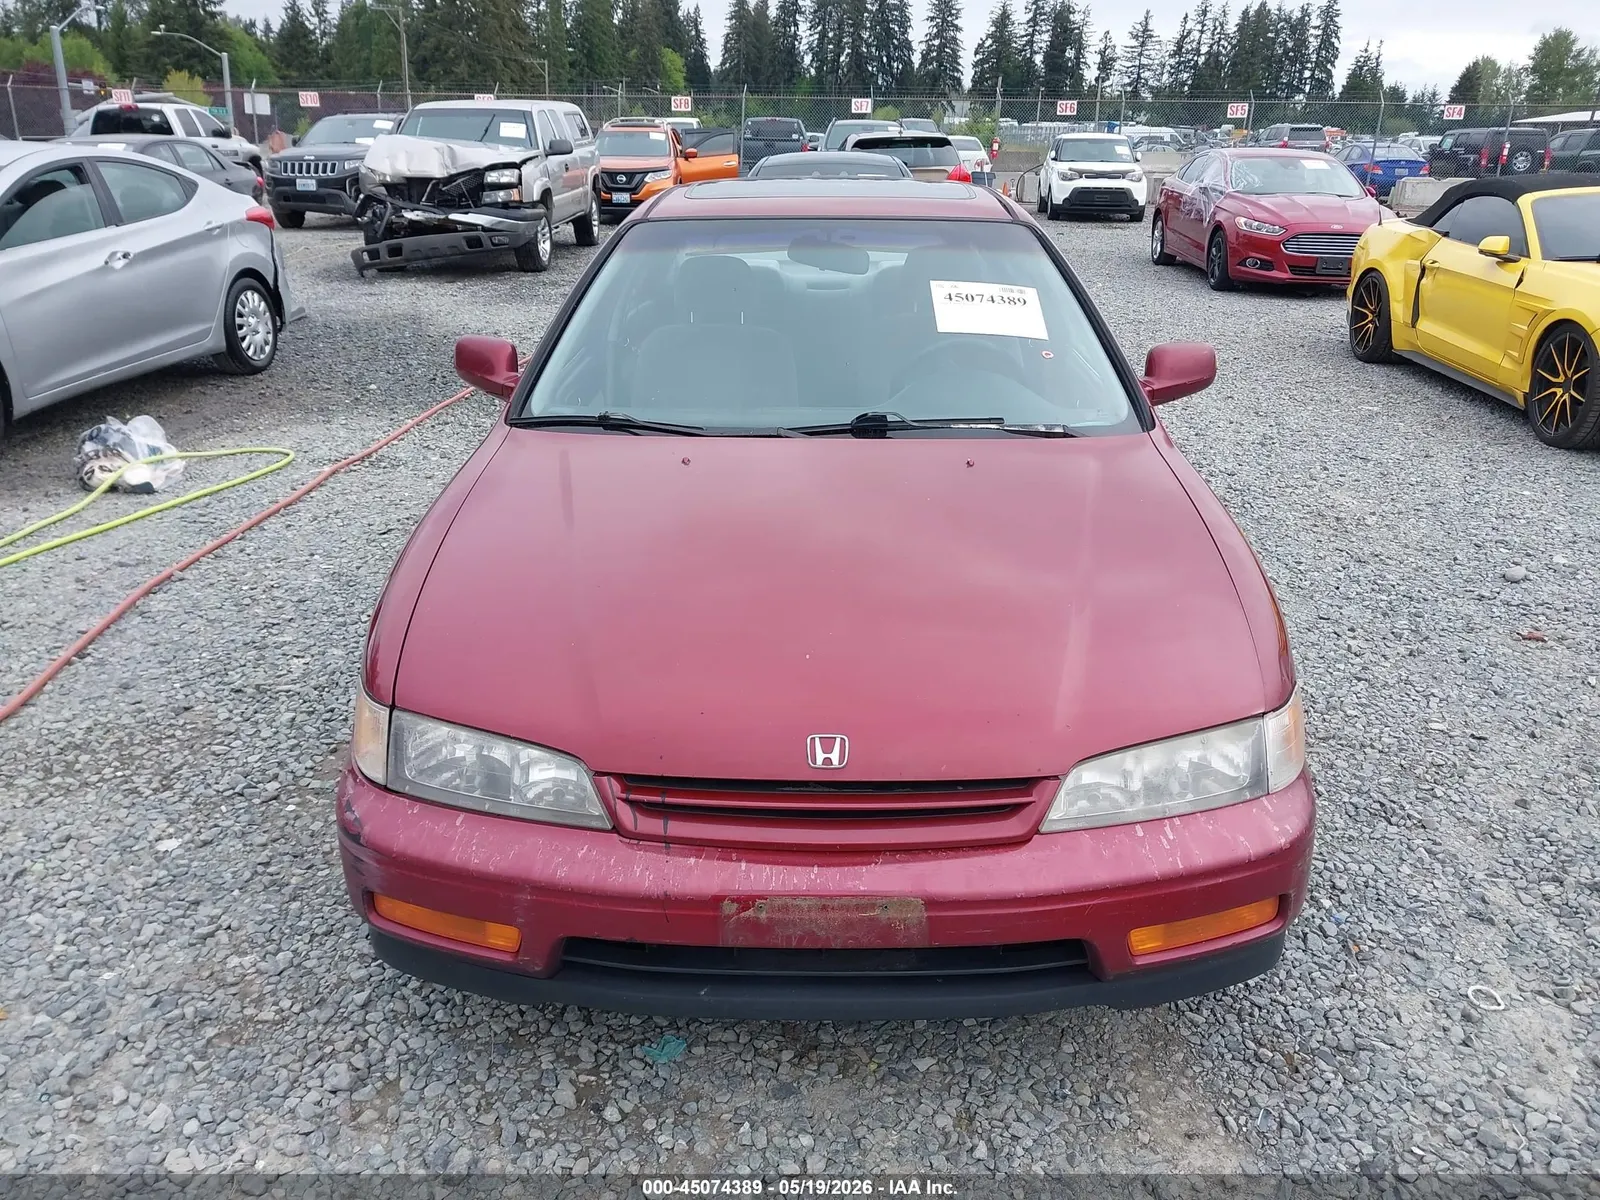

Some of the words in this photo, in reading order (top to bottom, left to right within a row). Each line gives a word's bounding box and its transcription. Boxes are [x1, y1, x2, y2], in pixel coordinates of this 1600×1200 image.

[113, 91, 131, 102] SF11
[300, 93, 318, 105] SF10
[673, 98, 690, 109] SF8
[853, 100, 869, 111] SF7
[1058, 102, 1075, 113] SF6
[1229, 104, 1246, 116] SF5
[1445, 106, 1463, 118] SF4
[943, 292, 1027, 306] 45074389
